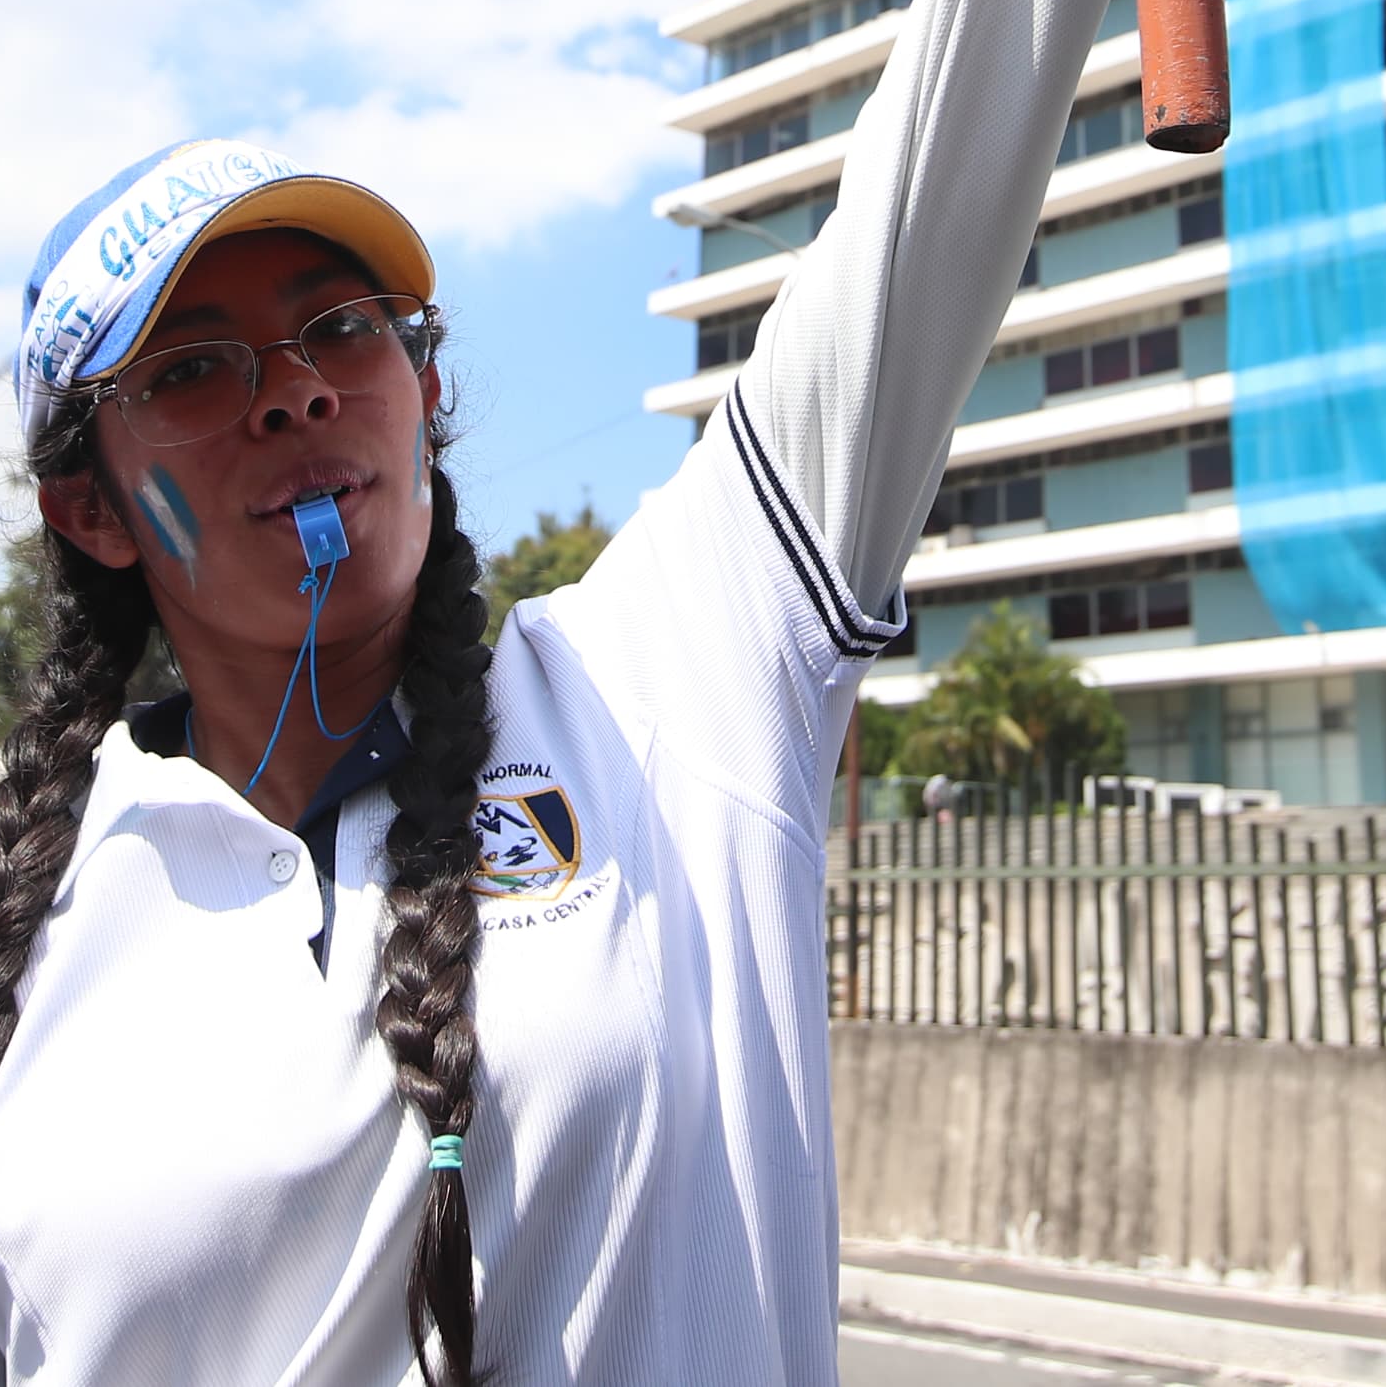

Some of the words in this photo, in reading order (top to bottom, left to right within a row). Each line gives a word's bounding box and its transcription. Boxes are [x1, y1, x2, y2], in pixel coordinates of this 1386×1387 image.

[35, 280, 68, 346] AMO
[482, 763, 553, 784] NORMAL
[483, 914, 537, 931] CASA
[544, 875, 611, 923] CENTRAL
